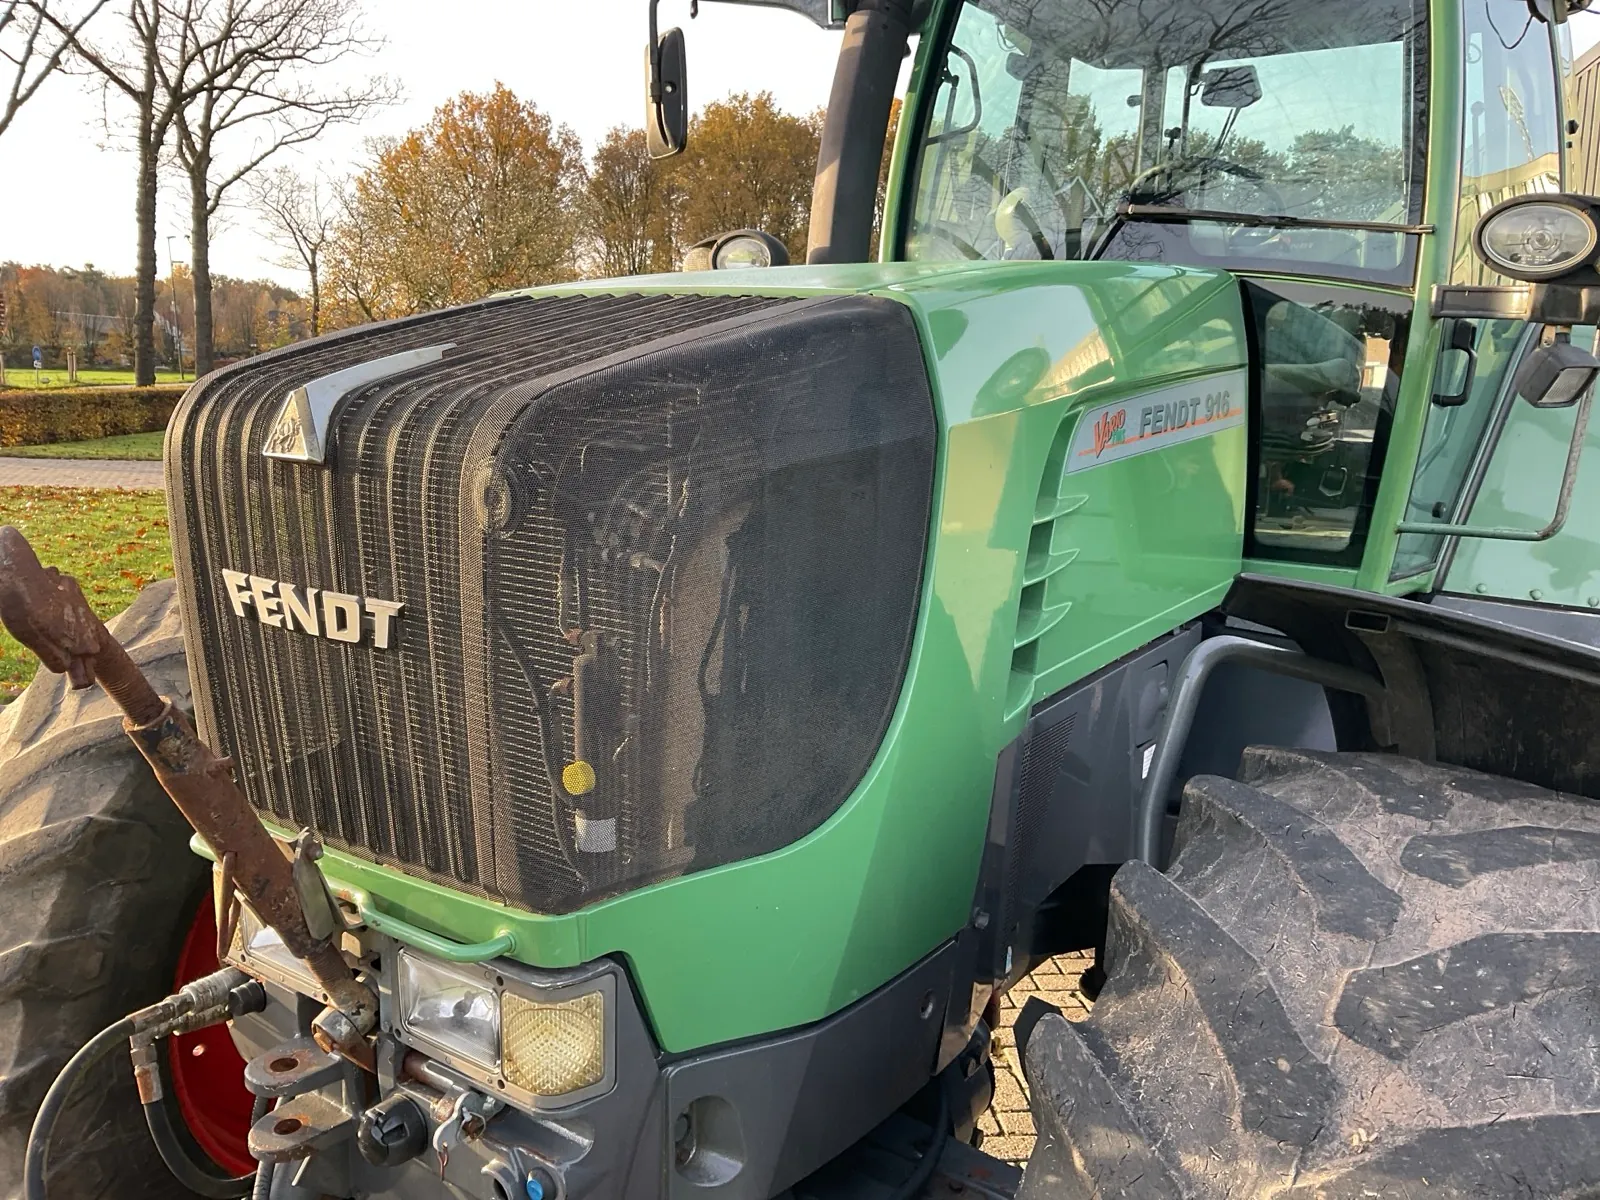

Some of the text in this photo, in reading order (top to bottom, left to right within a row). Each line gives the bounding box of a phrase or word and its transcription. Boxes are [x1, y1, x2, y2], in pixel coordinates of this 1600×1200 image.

[1139, 399, 1201, 438] FENDT
[1204, 390, 1231, 422] 916
[222, 568, 405, 649] FENDT
